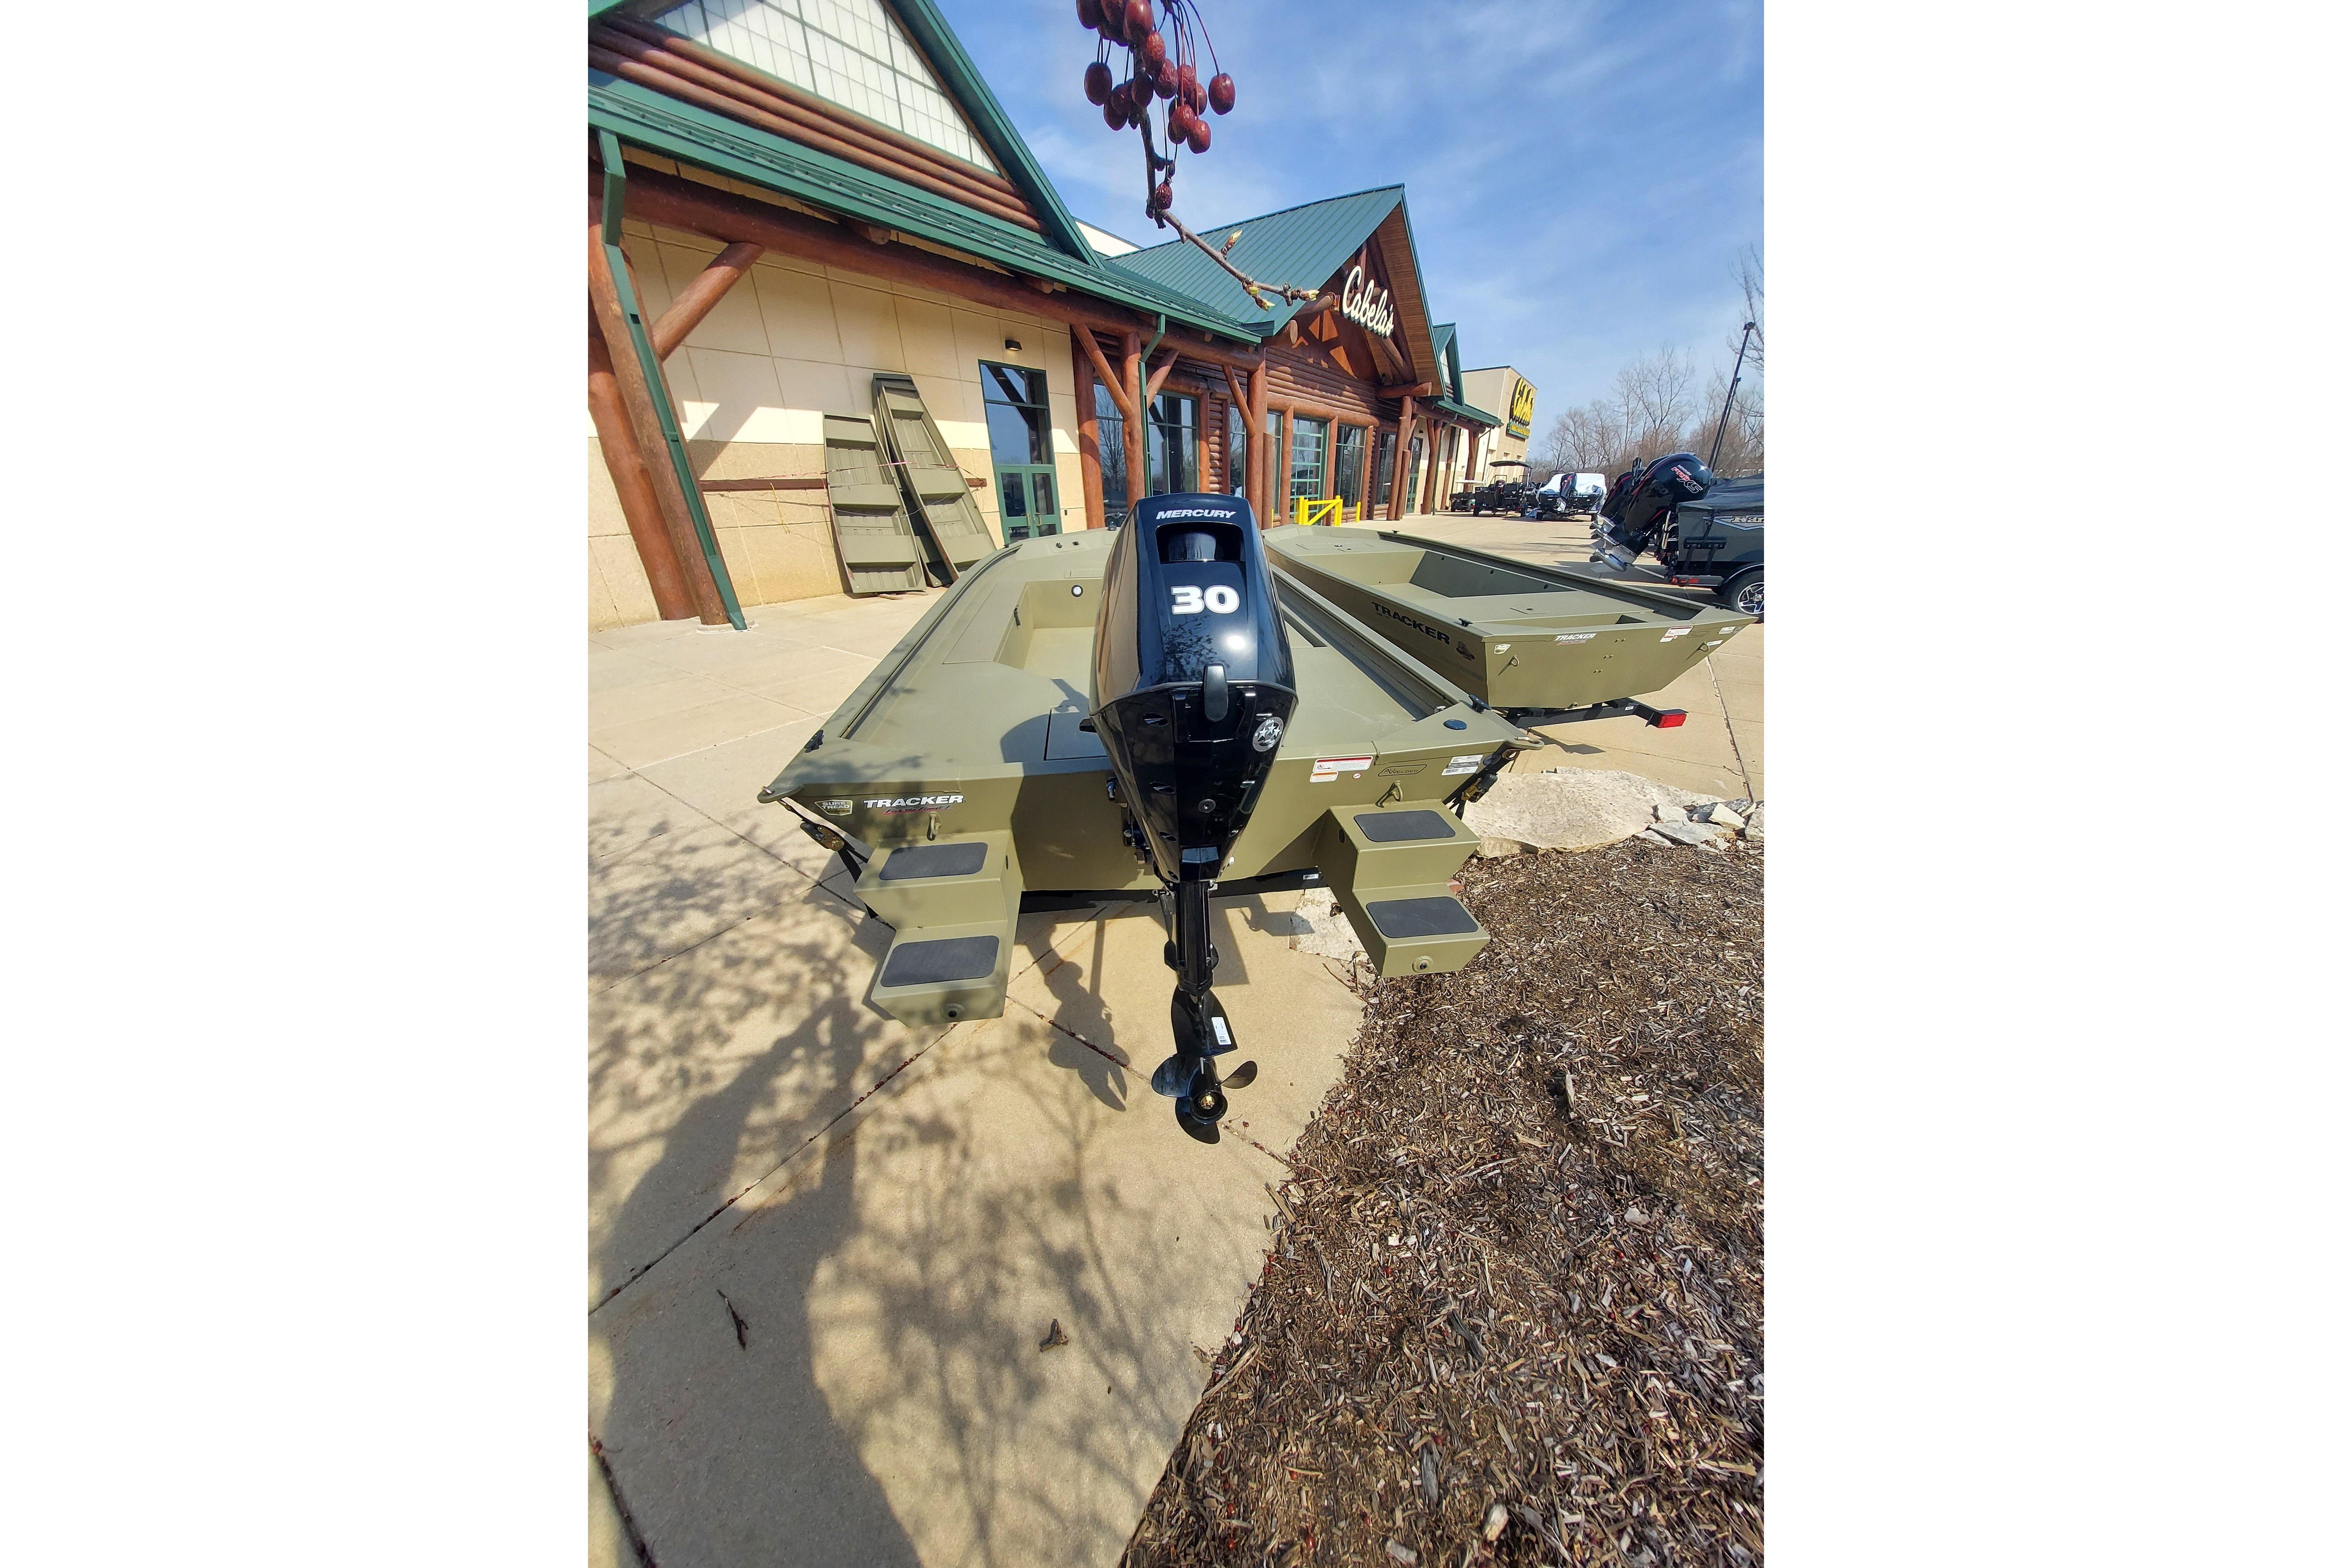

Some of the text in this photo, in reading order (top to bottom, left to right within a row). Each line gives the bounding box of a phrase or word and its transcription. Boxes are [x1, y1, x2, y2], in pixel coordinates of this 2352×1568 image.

[1343, 265, 1394, 336] Cabela's
[1676, 478, 1703, 493] XS
[1156, 509, 1237, 519] MERCURY
[1171, 584, 1240, 615] 30
[1371, 601, 1450, 645] TRACKER
[863, 795, 964, 808] TRACKER
